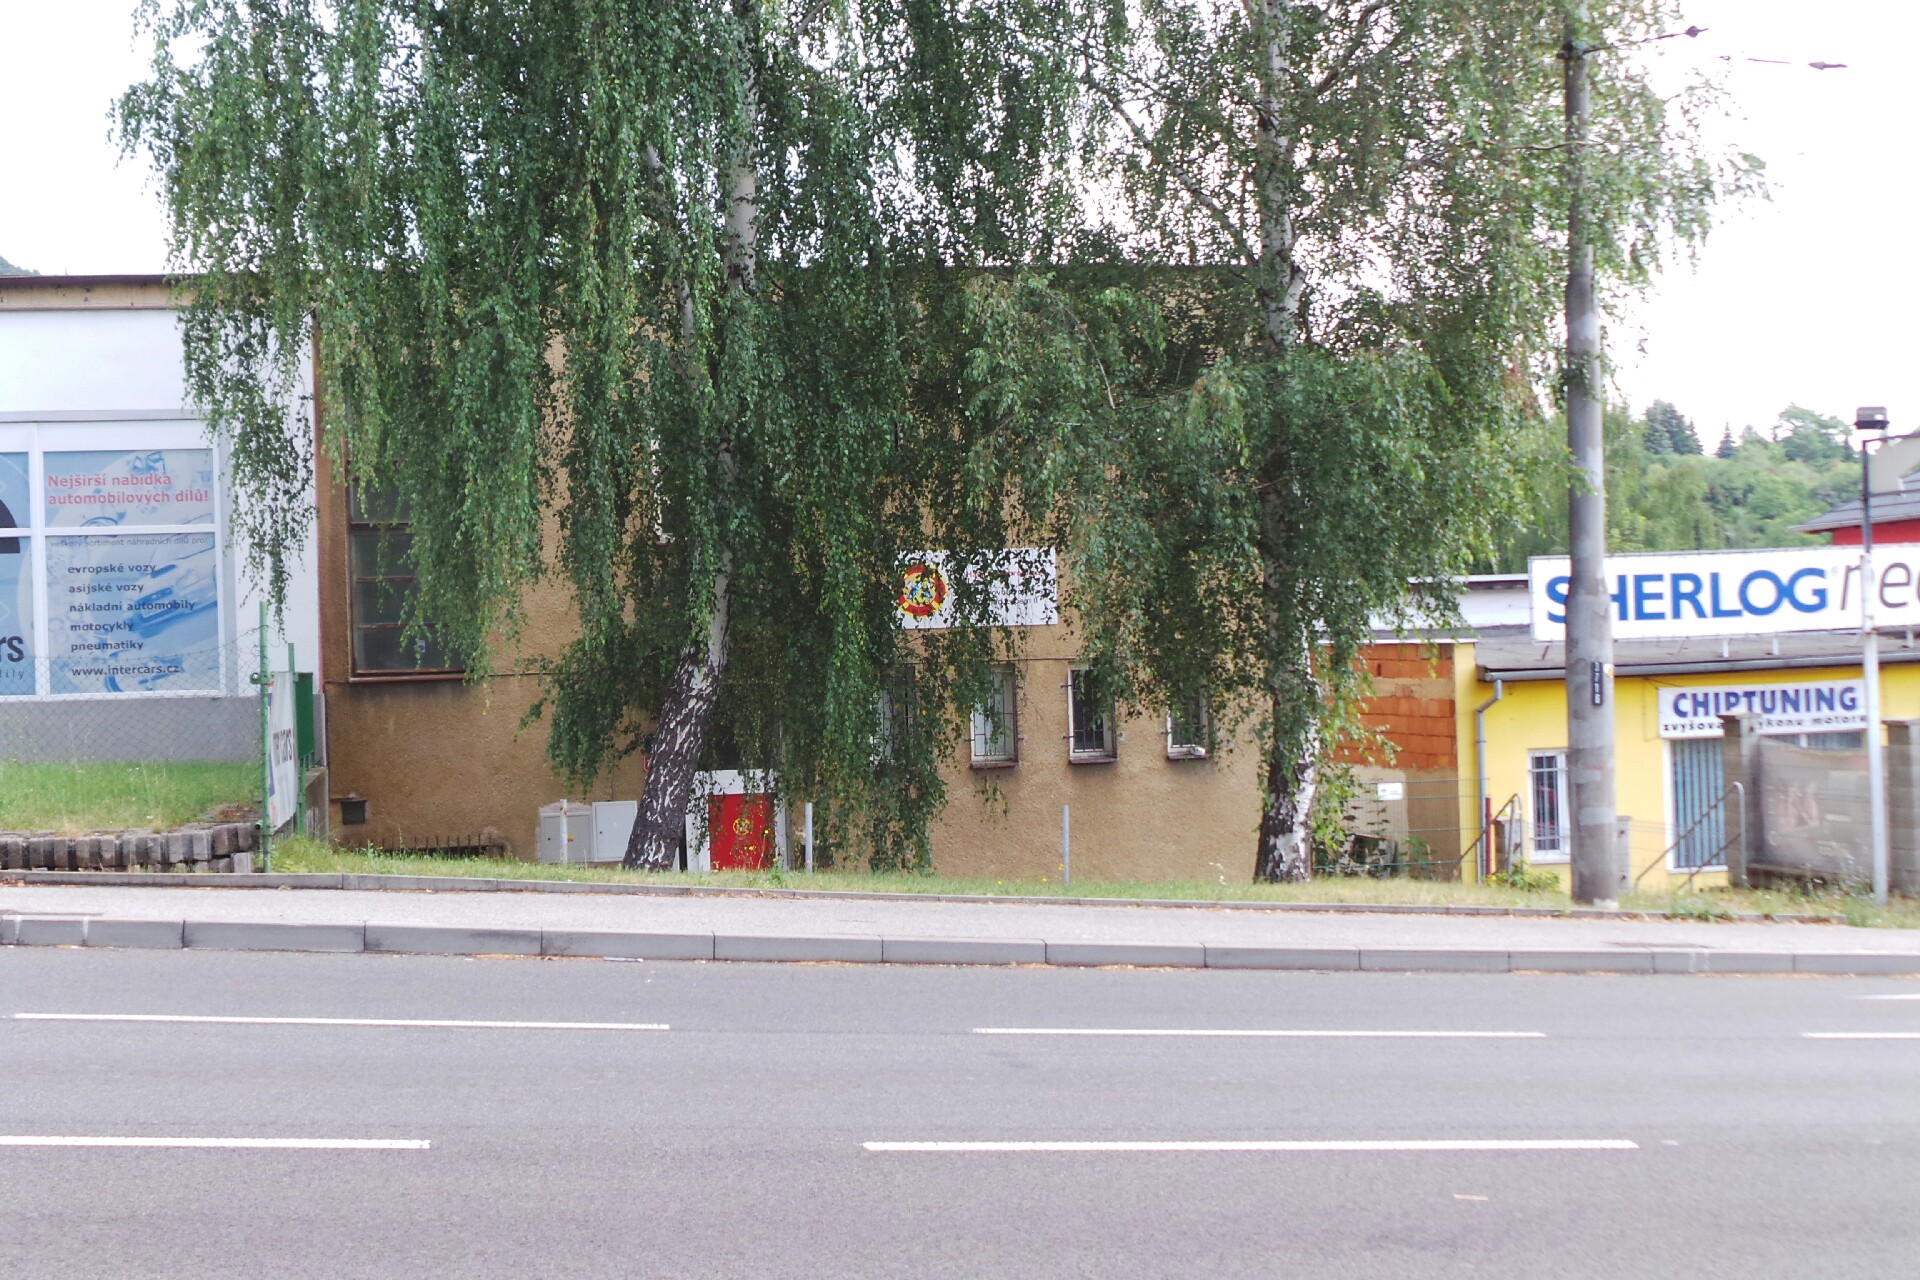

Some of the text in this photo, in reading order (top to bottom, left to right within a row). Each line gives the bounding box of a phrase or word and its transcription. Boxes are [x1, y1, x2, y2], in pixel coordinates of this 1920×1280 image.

[48, 473, 171, 489] Nejširší nabídka
[48, 488, 209, 505] automobilových dílů!
[68, 563, 156, 576] evropské vozy
[68, 582, 144, 595] asijské vozy
[69, 599, 195, 612] nákladní automobily
[70, 620, 134, 632] motocykly
[71, 639, 144, 653] pneumatiky
[71, 664, 180, 677] www.intercars.cz
[1673, 686, 1858, 718] CHIPTUNING
